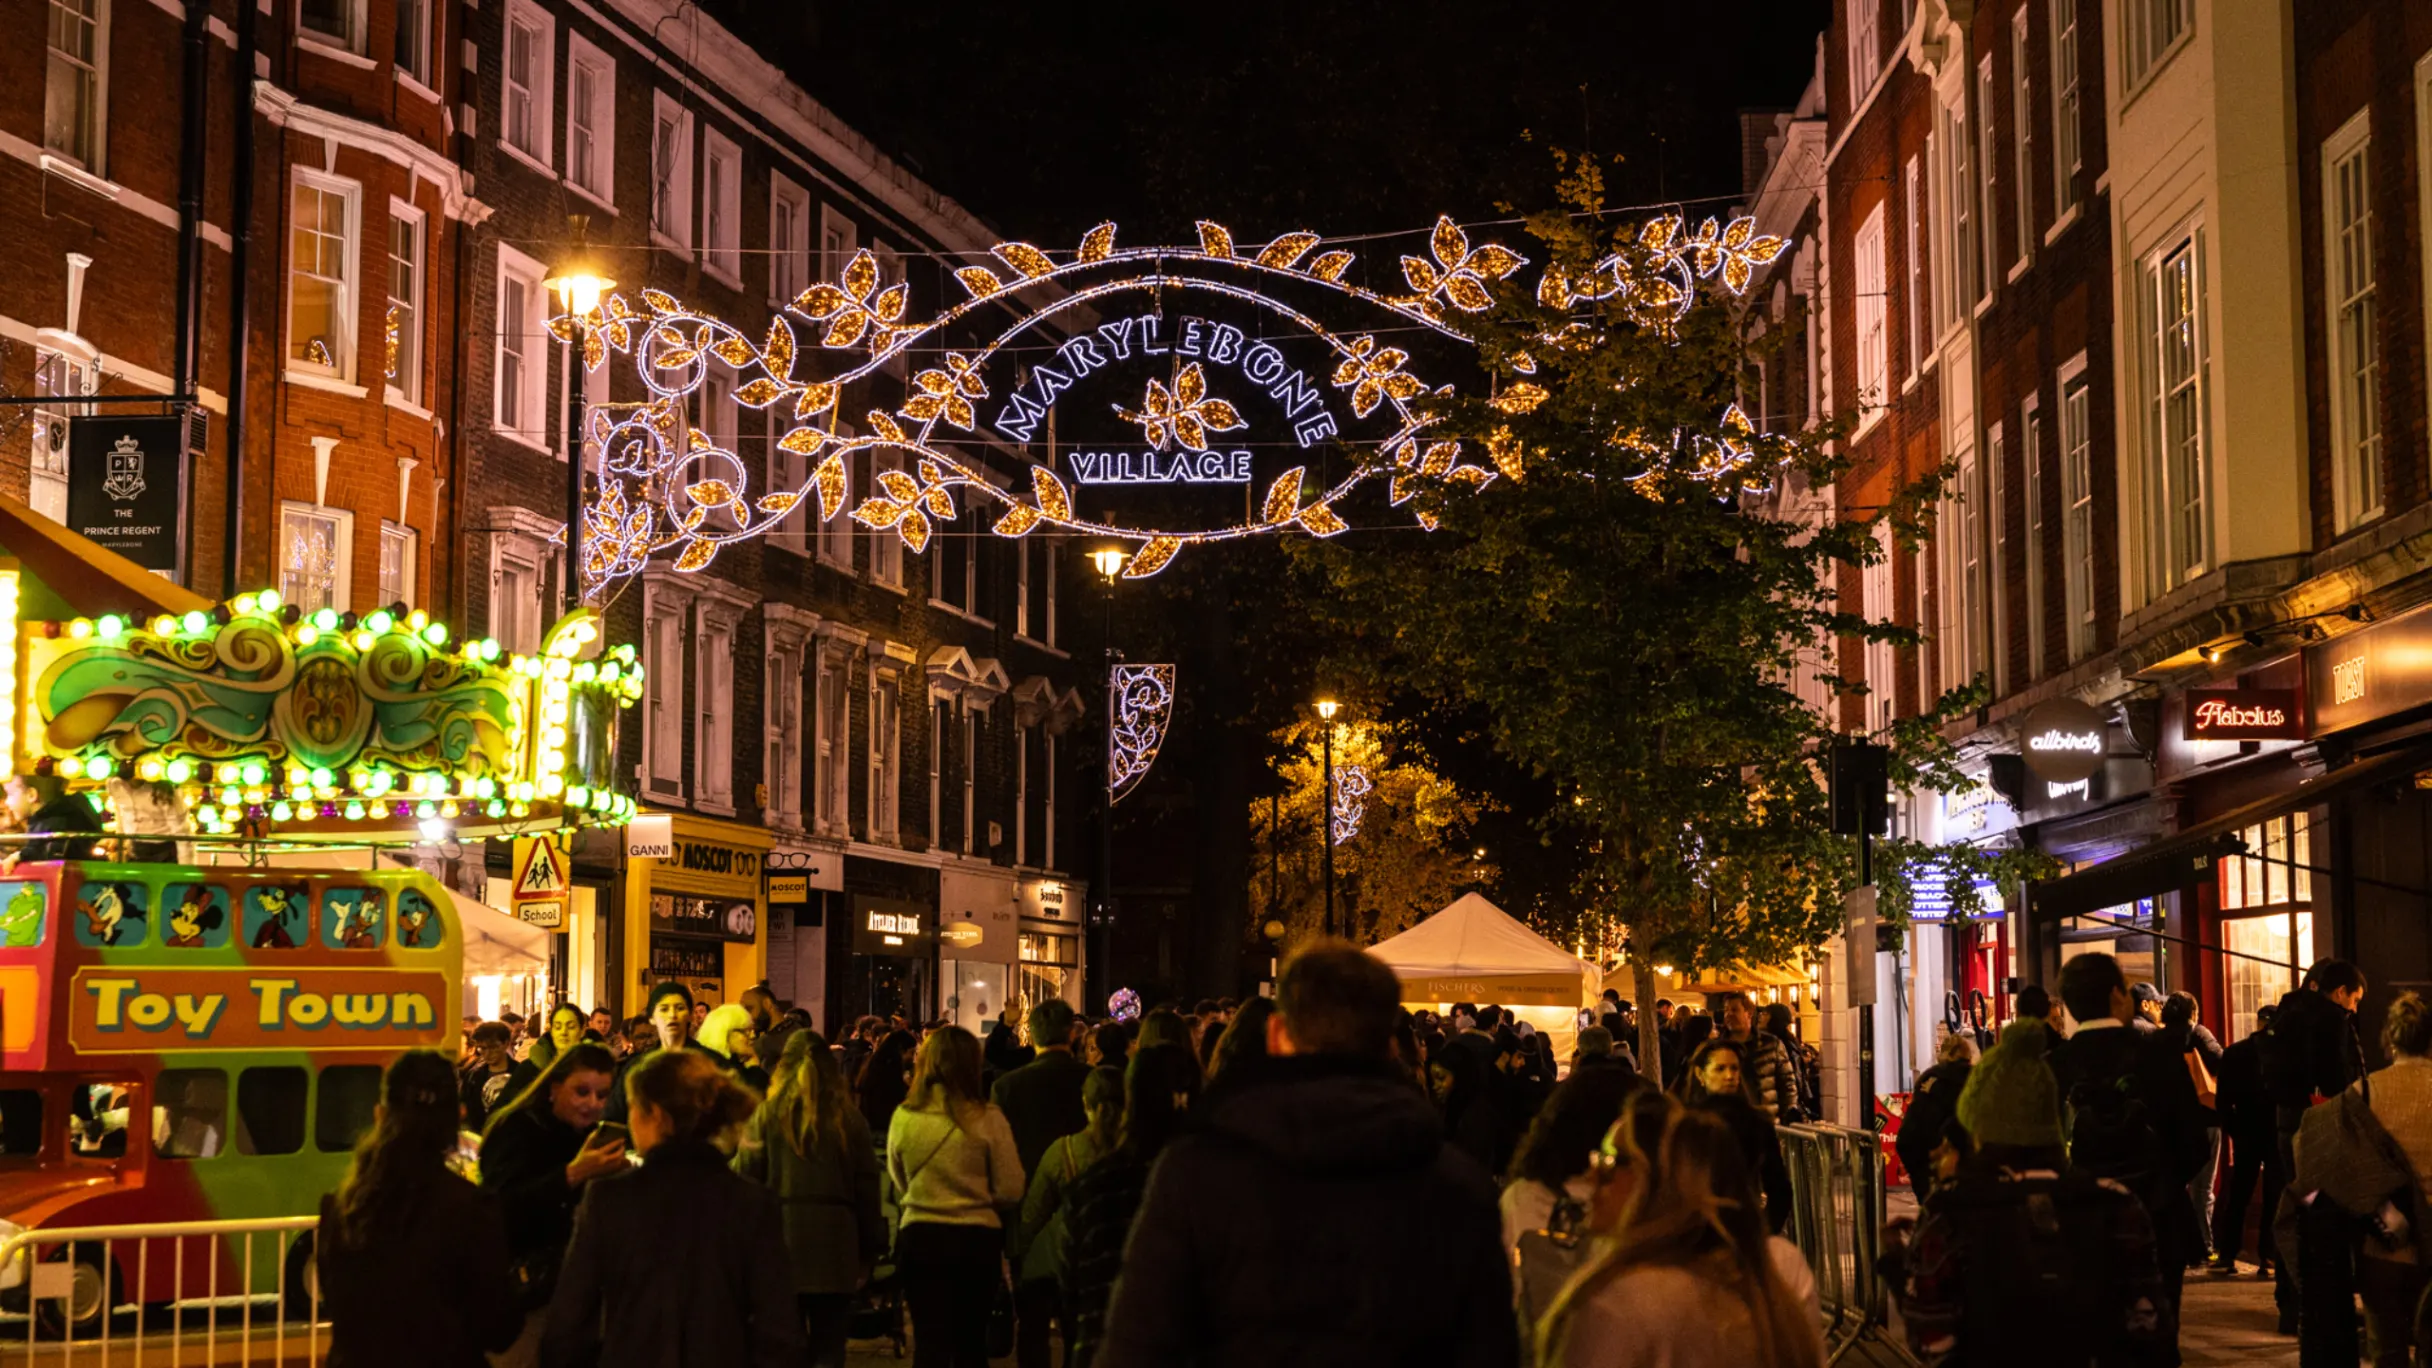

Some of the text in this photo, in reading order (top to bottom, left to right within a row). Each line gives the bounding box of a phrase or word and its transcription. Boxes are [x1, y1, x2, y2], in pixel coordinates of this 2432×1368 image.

[994, 315, 1339, 449] MARYLEBONE
[1069, 451, 1253, 483] VILLAGE
[114, 509, 133, 518] THE
[84, 525, 161, 536] PRINCE REGENT
[2333, 656, 2365, 705] TOAST
[2030, 729, 2101, 754] allbirds
[630, 844, 669, 856] GANNI
[683, 842, 733, 874] MOSCOT
[770, 883, 806, 892] MOSCOT
[523, 909, 557, 921] School
[86, 978, 436, 1037] Toy Town
